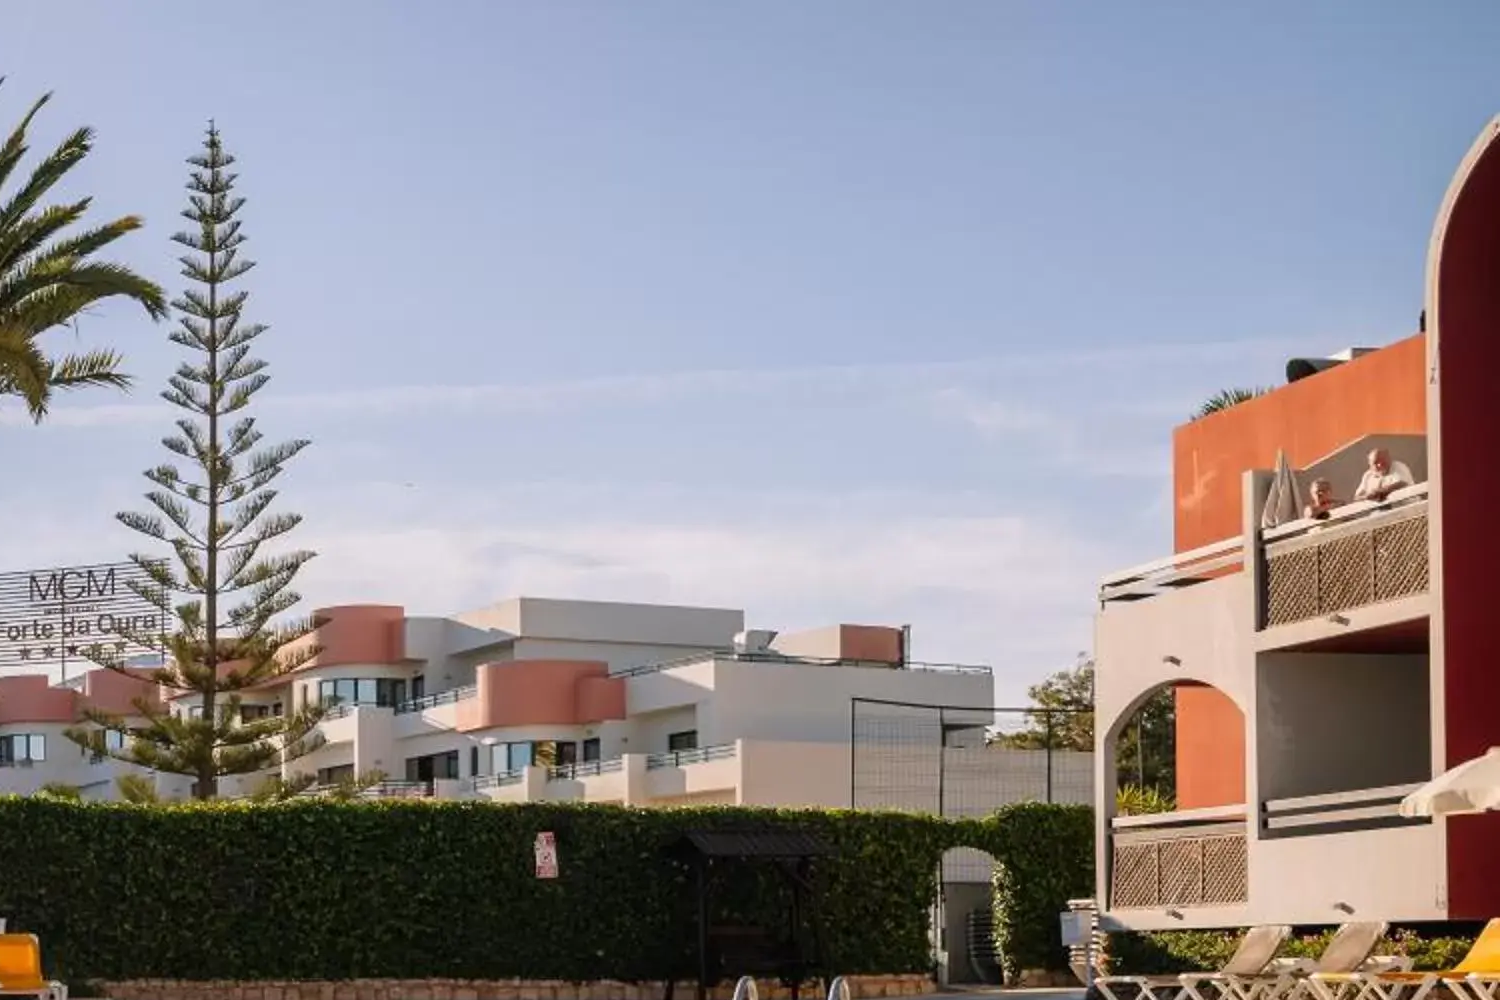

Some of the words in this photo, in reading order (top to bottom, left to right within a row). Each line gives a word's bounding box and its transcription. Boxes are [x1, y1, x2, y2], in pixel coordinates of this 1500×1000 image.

[29, 568, 115, 600] MGM
[62, 616, 90, 637] da
[97, 613, 156, 635] Oura
